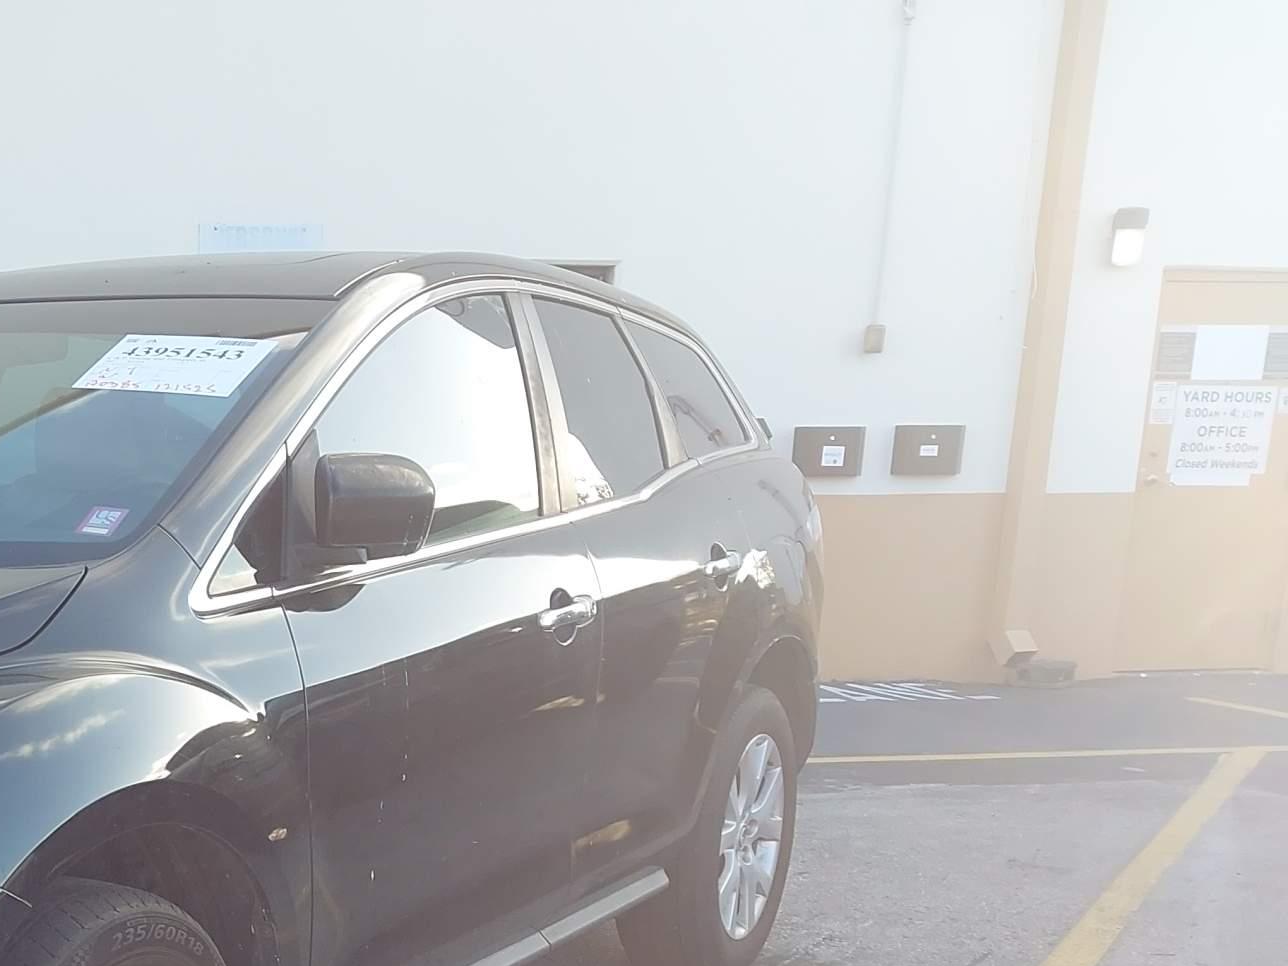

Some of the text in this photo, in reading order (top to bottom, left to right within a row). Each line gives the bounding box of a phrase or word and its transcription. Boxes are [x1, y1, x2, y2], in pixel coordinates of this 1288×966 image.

[122, 347, 246, 360] 43951543
[1183, 390, 1220, 403] YARD
[1224, 391, 1273, 404] HOURS
[1197, 425, 1248, 438] OFFICE
[1175, 458, 1258, 469] Closed Weekends
[112, 923, 205, 957] 235/60R18
